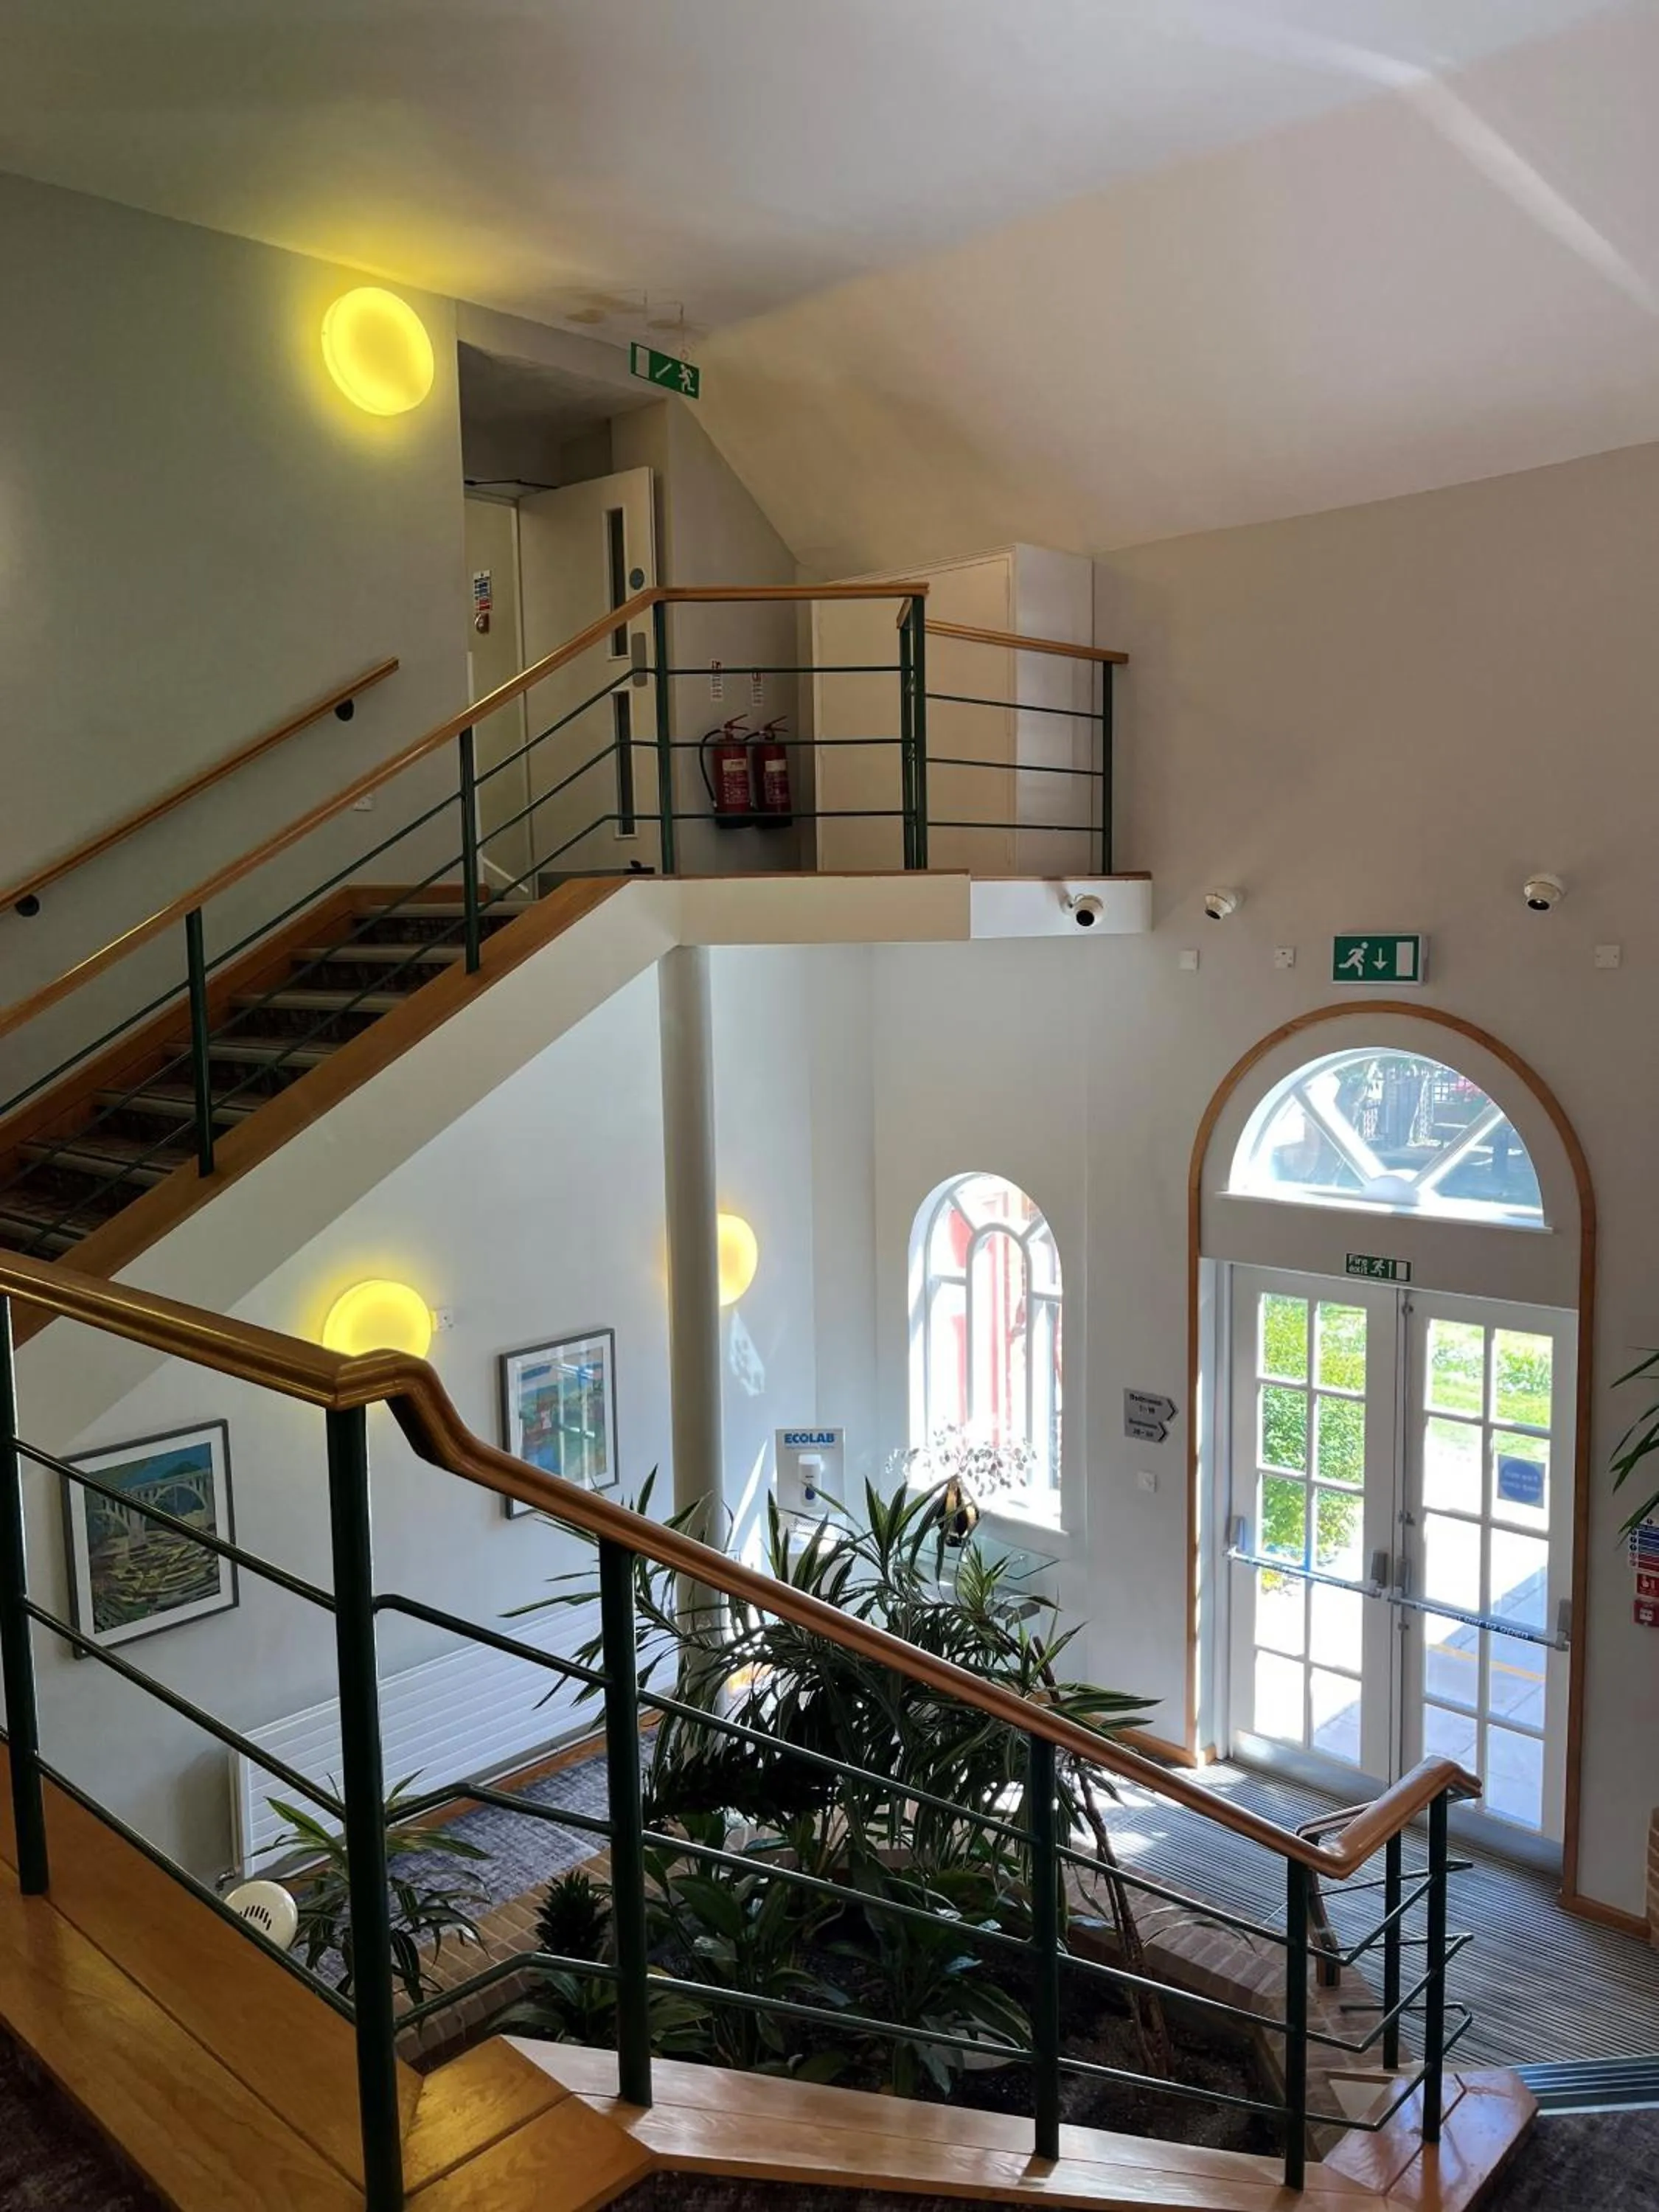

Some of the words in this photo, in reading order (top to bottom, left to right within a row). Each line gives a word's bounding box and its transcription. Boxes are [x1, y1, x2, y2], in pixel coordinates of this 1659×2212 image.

[1349, 1255, 1368, 1265] Fire
[1349, 1265, 1368, 1275] exit
[784, 1433, 835, 1443] ECOLAB
